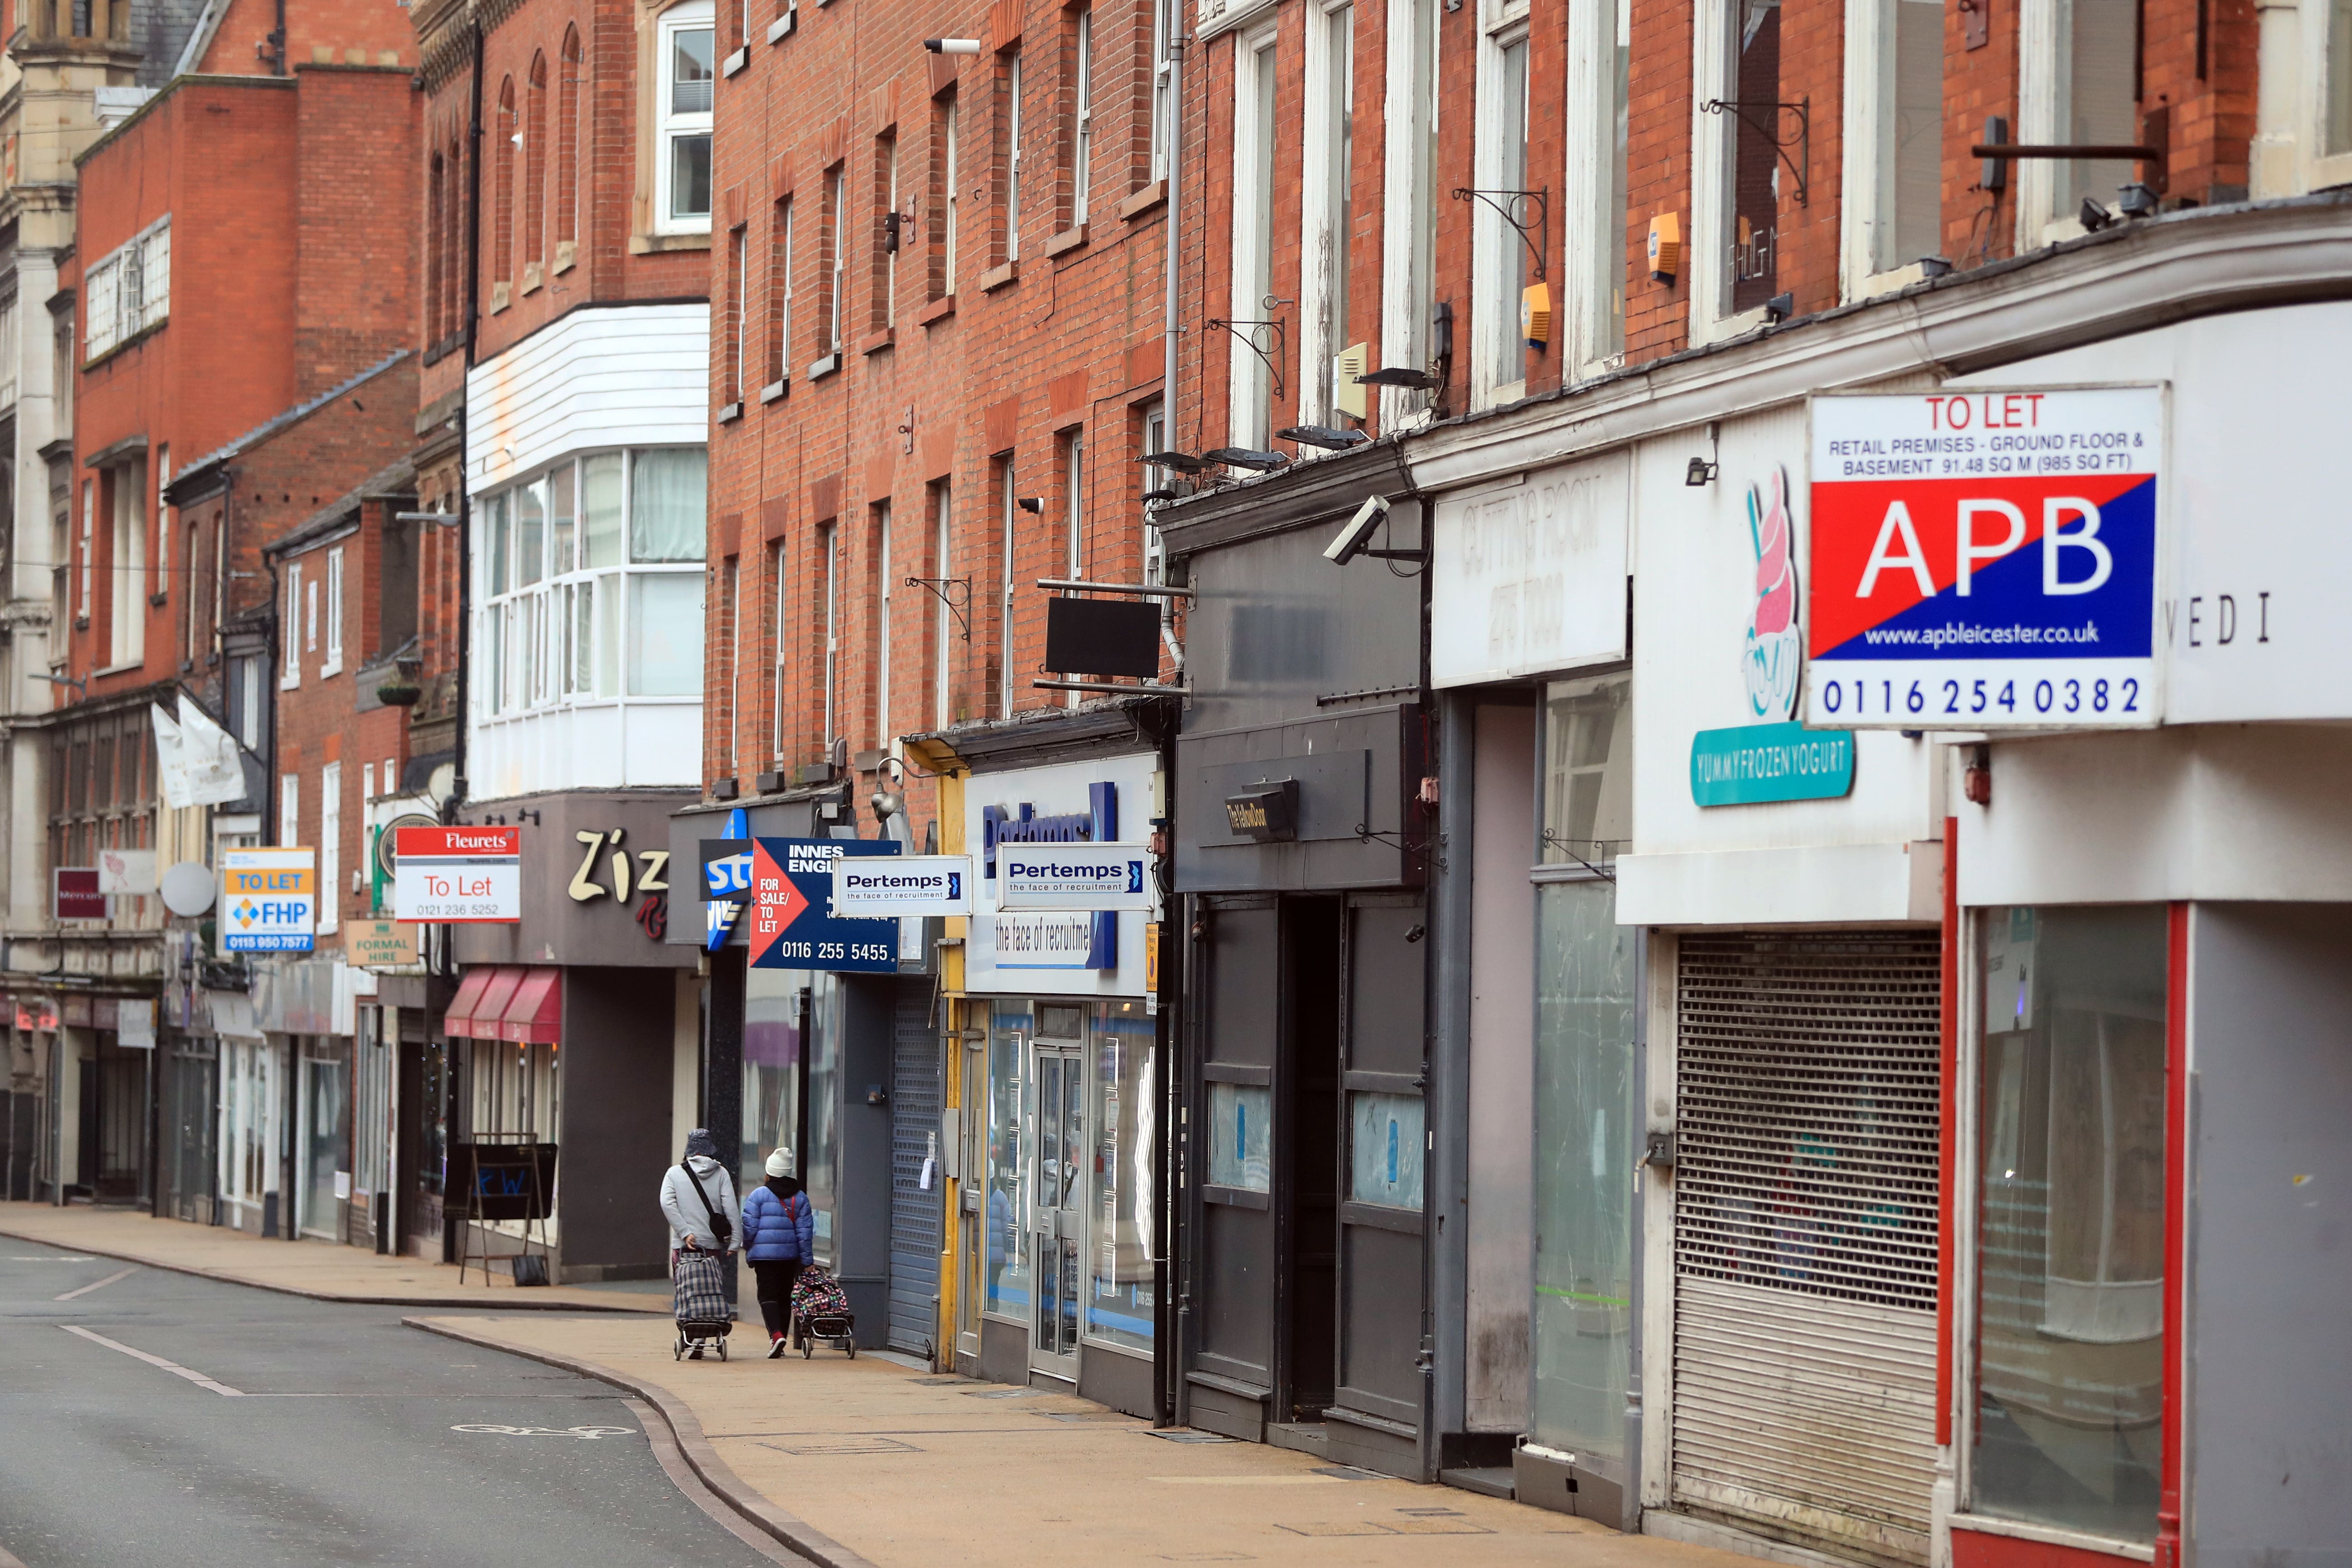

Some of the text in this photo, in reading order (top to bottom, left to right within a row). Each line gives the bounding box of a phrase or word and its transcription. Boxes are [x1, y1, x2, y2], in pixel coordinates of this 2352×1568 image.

[1926, 394, 2044, 430] TO LET
[1830, 439, 1883, 455] RETAIL
[1892, 436, 1974, 454] PREMISES
[1991, 434, 2063, 451] GROUND
[2071, 433, 2127, 449] FLOOR
[2133, 432, 2144, 448] &
[1843, 453, 2132, 476] BASEMENT 91.48 SQ M (985 SQ FT)
[1855, 496, 2113, 598] APB
[1865, 621, 2099, 650] www.apbleicester.co.uk
[1823, 678, 2140, 714] 0116 254 0382
[446, 832, 507, 848] Fleurets
[789, 844, 843, 858] INNES
[567, 828, 669, 903] Ziz
[788, 859, 833, 873] ENGL
[1010, 863, 1122, 880] Pertemps
[237, 874, 302, 889] TO LET
[424, 875, 492, 896] To Let
[760, 878, 778, 890] FOR
[847, 875, 942, 889] Pertemps
[760, 892, 789, 906] SALE/
[262, 903, 307, 924] FHP
[417, 904, 498, 916] 0121 236 5252
[760, 906, 773, 918] TO
[759, 920, 778, 933] LET
[996, 916, 1090, 951] the face of recruitme
[356, 939, 408, 951] FORMAL
[782, 941, 888, 961] 0116 255 5455
[369, 951, 397, 962] HIRE
